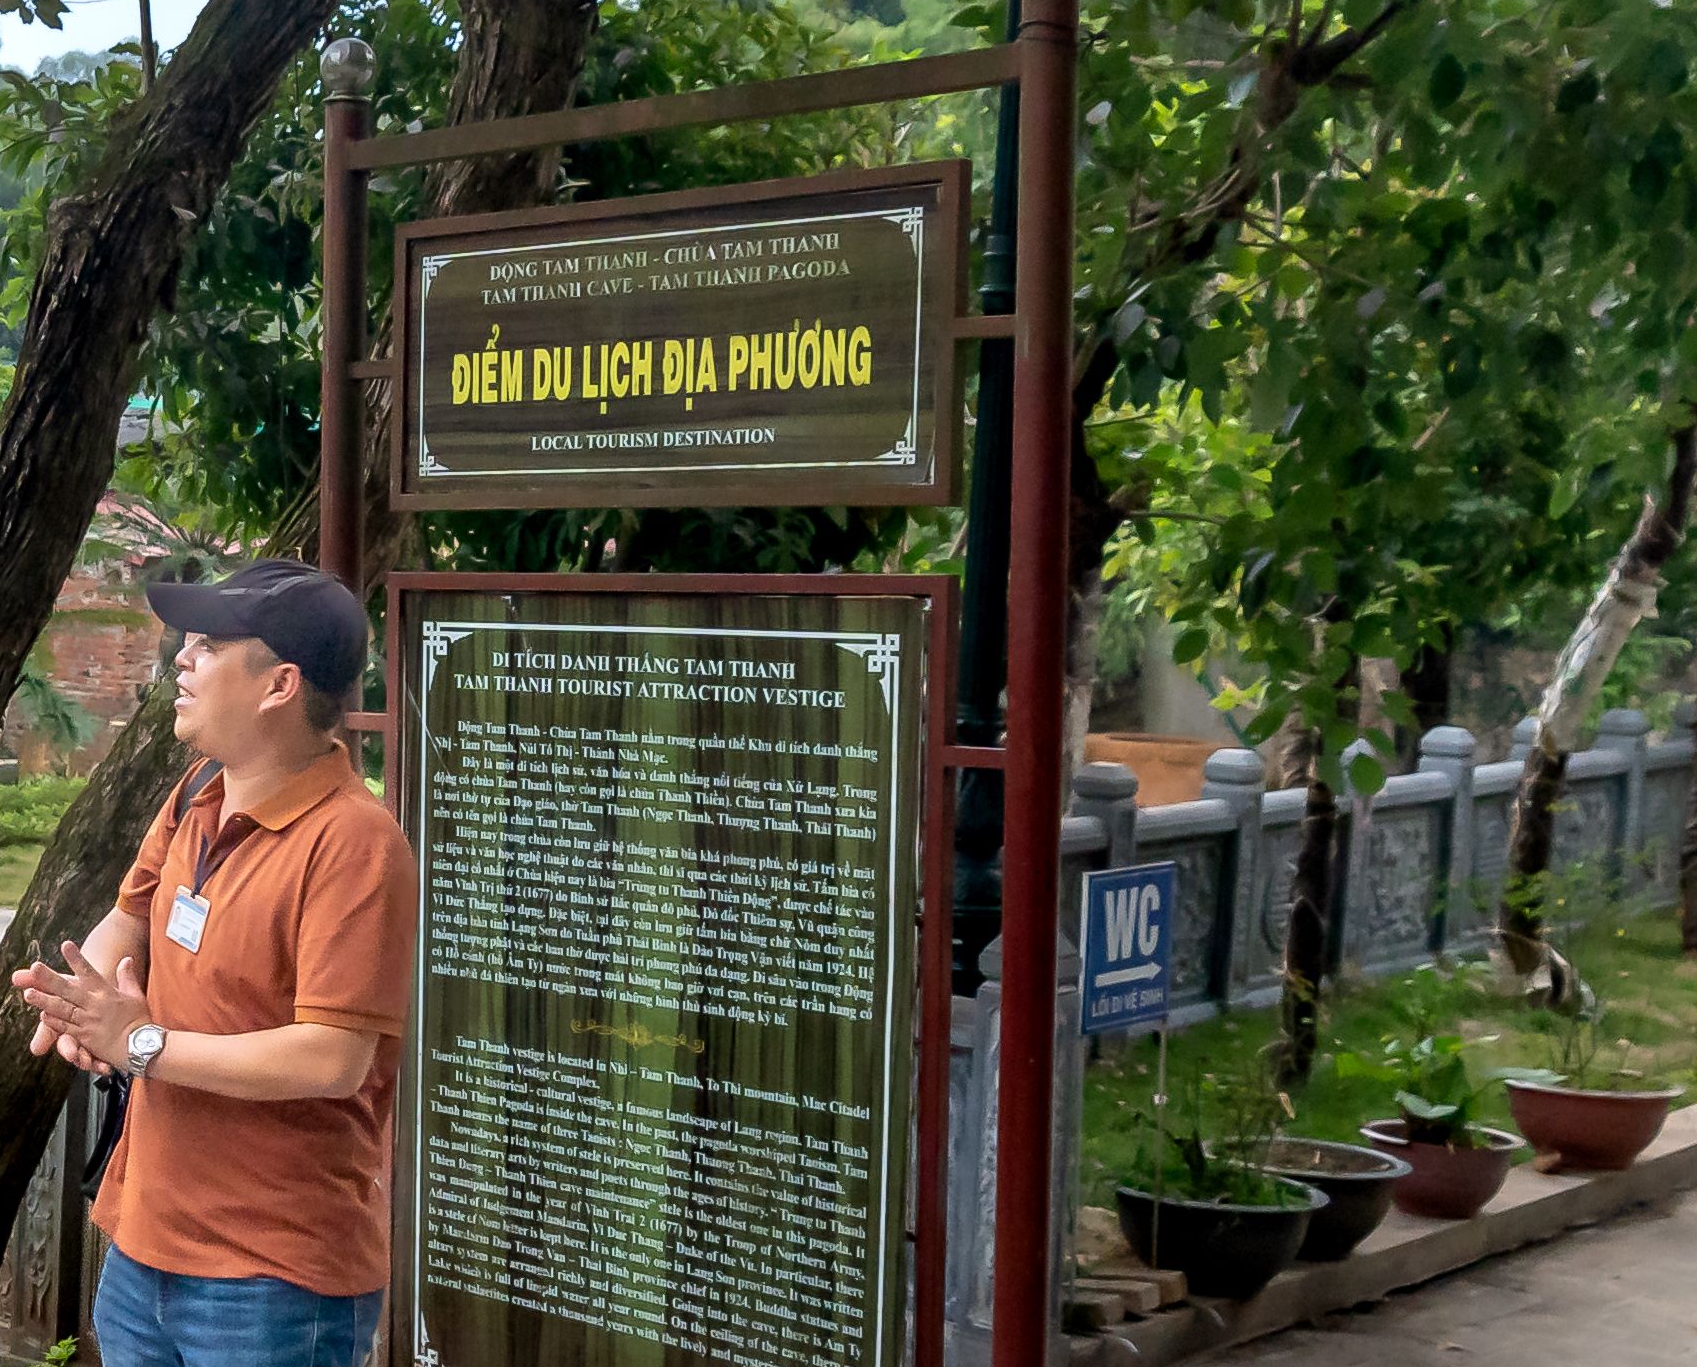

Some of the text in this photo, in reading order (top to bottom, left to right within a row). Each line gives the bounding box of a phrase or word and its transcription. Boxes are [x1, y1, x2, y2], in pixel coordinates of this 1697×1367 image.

[542, 257, 579, 275] TAM
[584, 251, 647, 271] THANH
[720, 239, 762, 260] TAM
[768, 232, 839, 254] THANH
[480, 287, 516, 305] TAM
[520, 281, 581, 302] THANH
[586, 277, 632, 296] CAVE
[648, 272, 688, 291] TAM
[693, 266, 761, 286] THANH
[767, 259, 850, 281] PAGODA
[451, 319, 871, 414] ĐIỂM DU LỊCH ĐỊA PHƯƠNG
[530, 427, 775, 451] LOCAL TOURISM DESTINATION
[492, 651, 510, 668] DI
[513, 648, 555, 669] TÍCH
[560, 654, 610, 671] DANH
[683, 658, 723, 676] TAM
[728, 660, 795, 679] THANH
[453, 673, 845, 708] TAM THANH TOURIST ATTRACTION VESTIGE
[748, 737, 772, 752] Khu
[1105, 884, 1161, 962] WC
[707, 1077, 720, 1092] To
